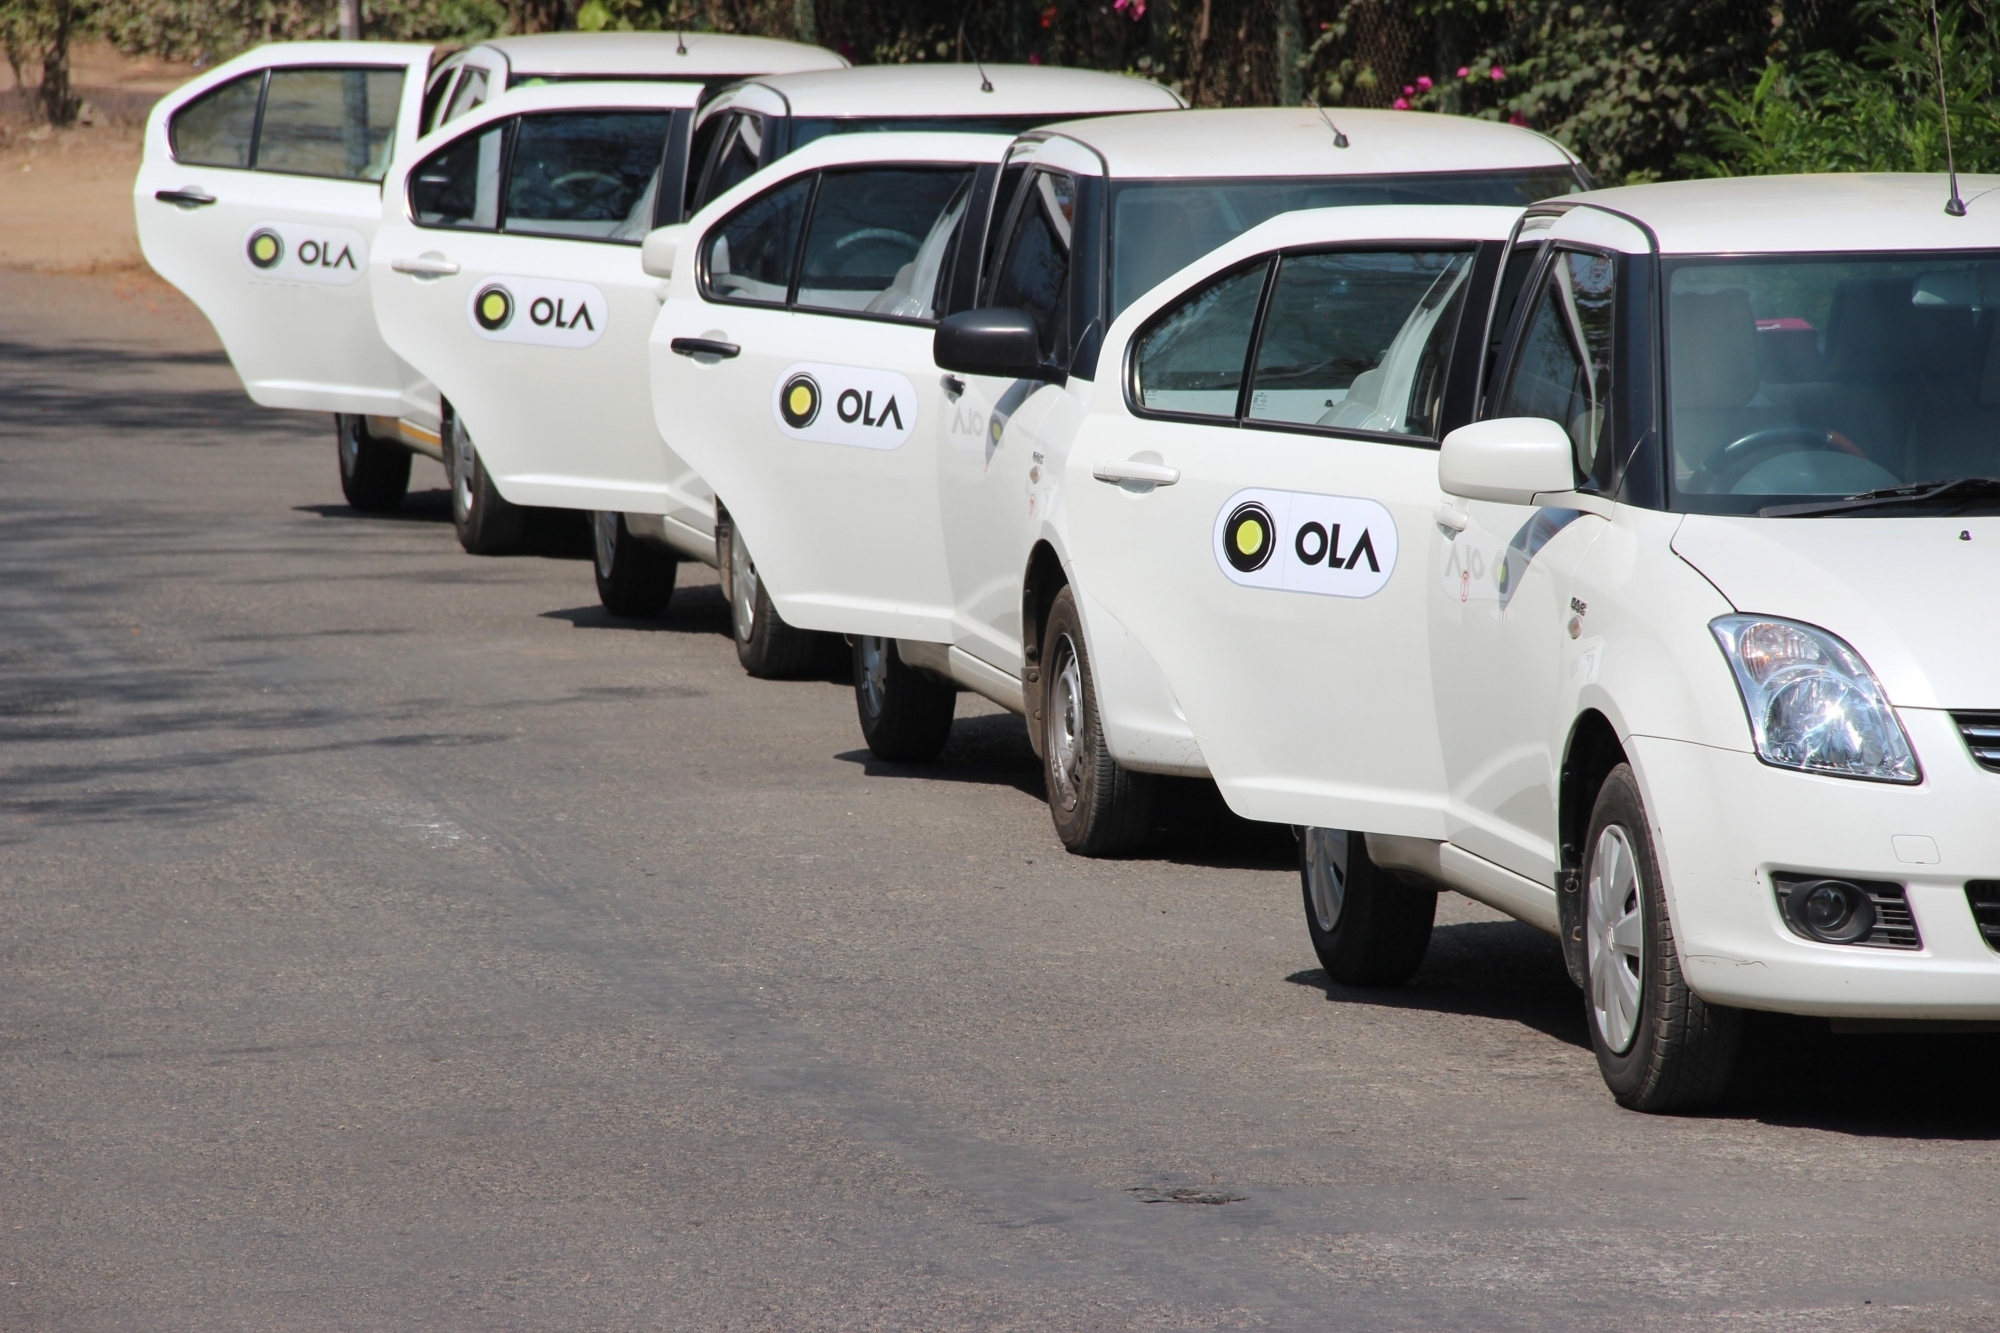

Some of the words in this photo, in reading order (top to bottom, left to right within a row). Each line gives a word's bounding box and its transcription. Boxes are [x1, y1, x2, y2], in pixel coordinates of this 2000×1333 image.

[298, 240, 356, 270] OLA
[530, 297, 594, 331] OLA
[837, 388, 903, 430] OLA
[1295, 521, 1382, 573] OLA
